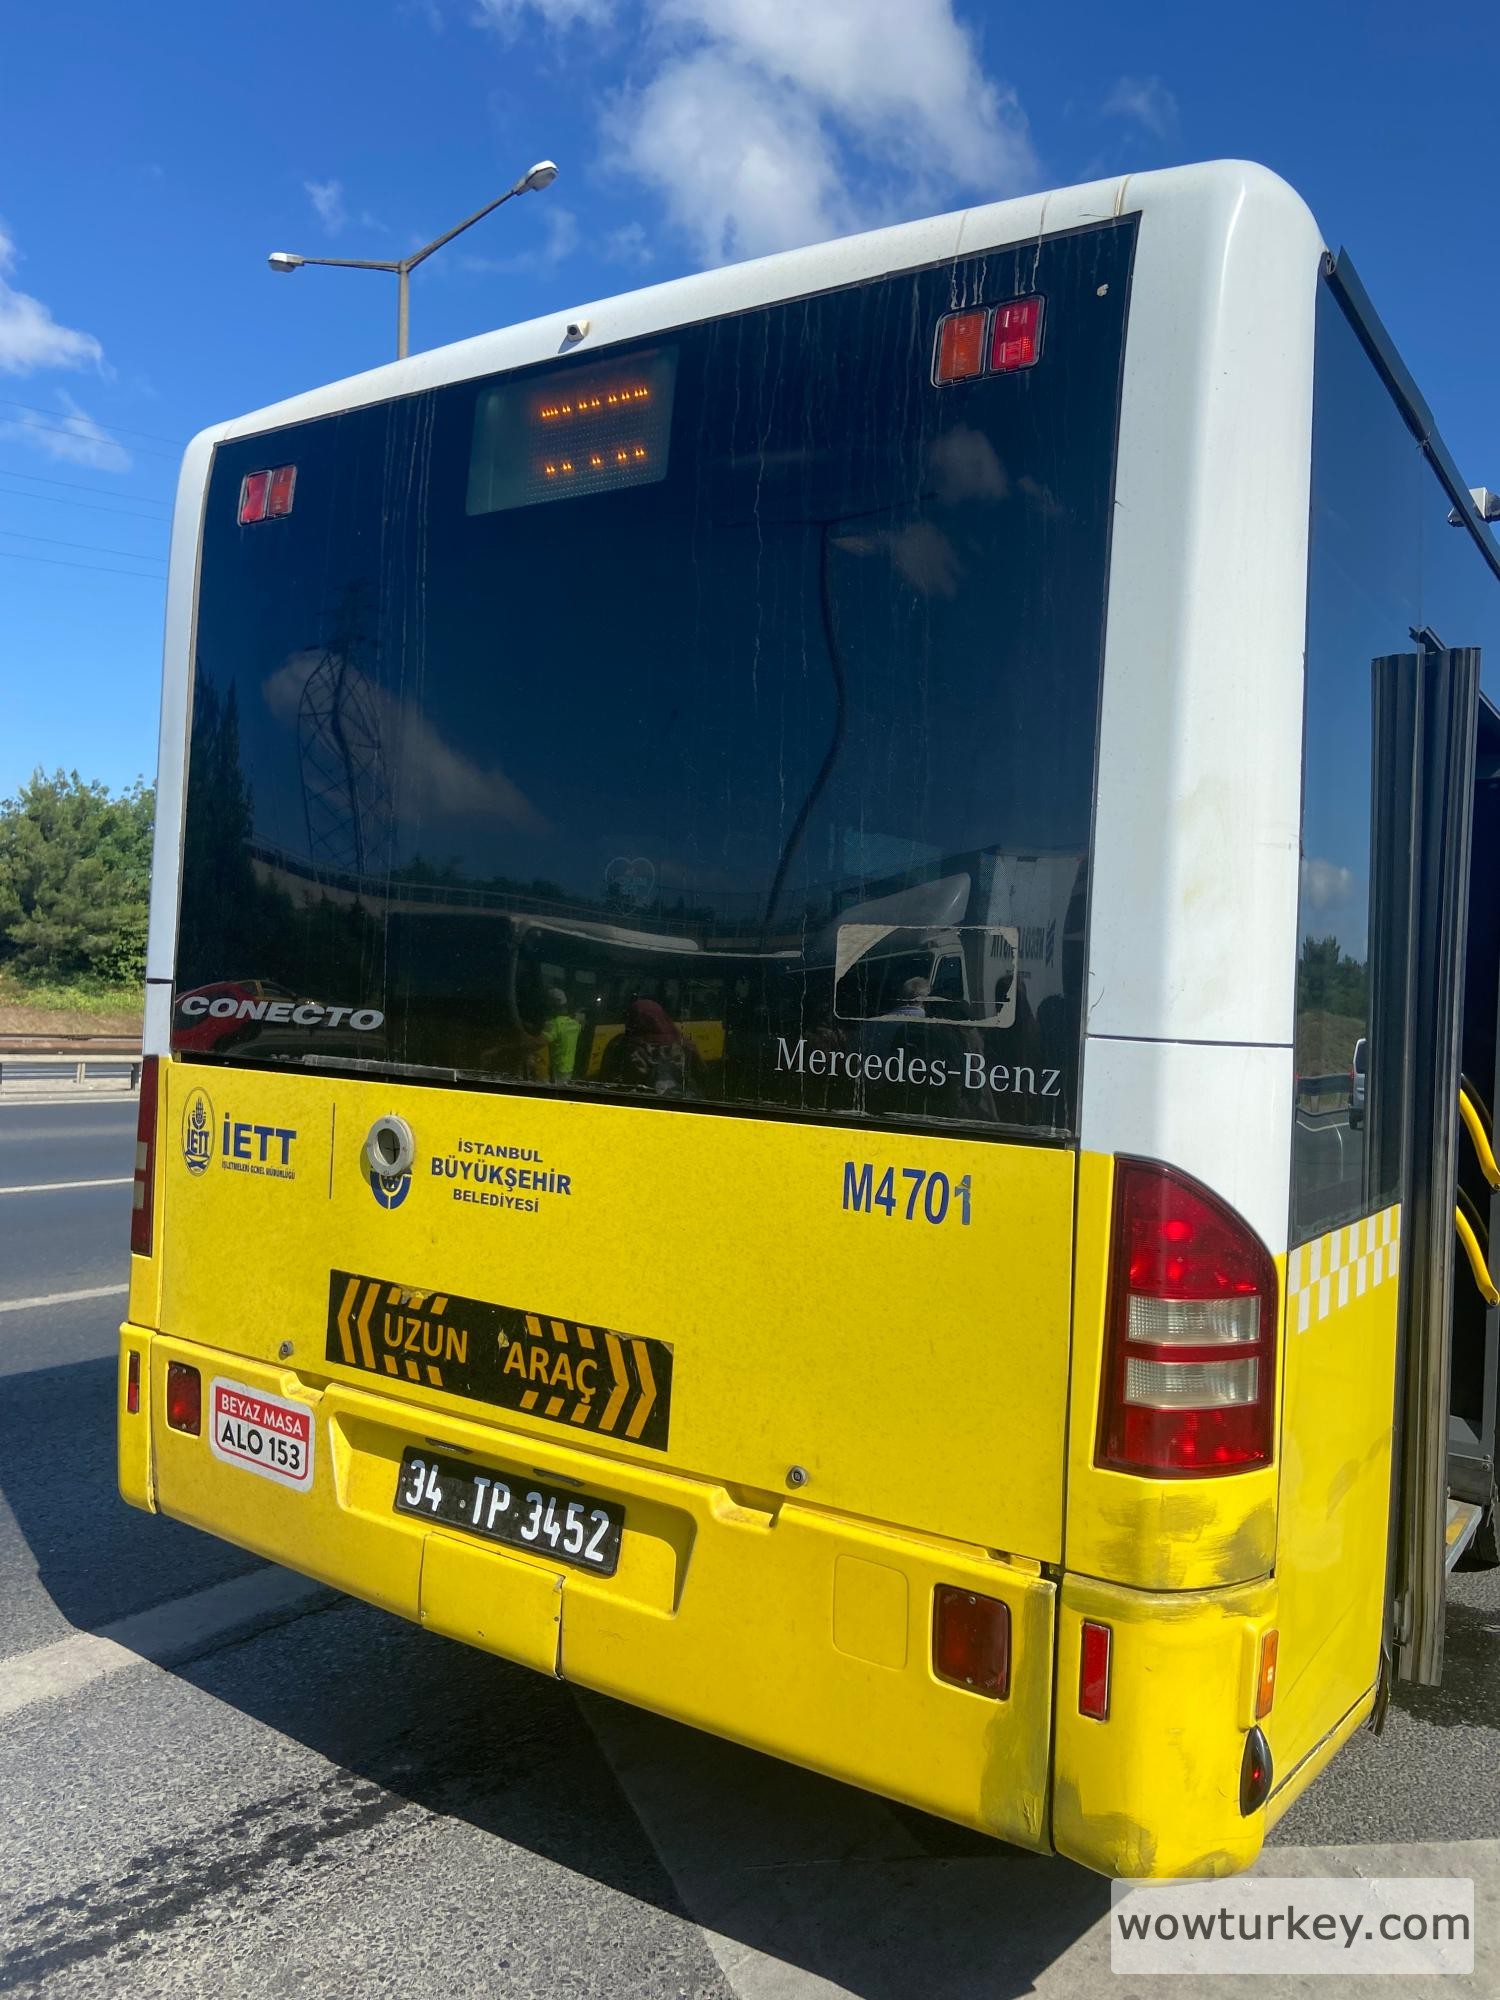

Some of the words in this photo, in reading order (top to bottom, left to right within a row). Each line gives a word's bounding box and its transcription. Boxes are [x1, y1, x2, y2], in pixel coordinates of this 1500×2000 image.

[181, 996, 384, 1031] CONECTO
[774, 1037, 1061, 1097] Mercedes-Benz
[222, 1112, 297, 1165] İETT
[457, 1138, 543, 1163] İSTANBUL
[431, 1155, 572, 1196] BÜYÜKŞEHİR
[453, 1188, 540, 1213] BELEDİYESİ
[842, 1162, 972, 1226] M4701
[383, 1312, 468, 1364] UZUN
[503, 1342, 598, 1404] ARAÇ
[221, 1394, 262, 1421] BEYAZ
[263, 1407, 304, 1437] MASA
[221, 1419, 263, 1455] ALO
[268, 1437, 301, 1471] 153
[405, 1460, 443, 1512] 34
[472, 1476, 511, 1528] TP
[520, 1492, 611, 1562] 3452
